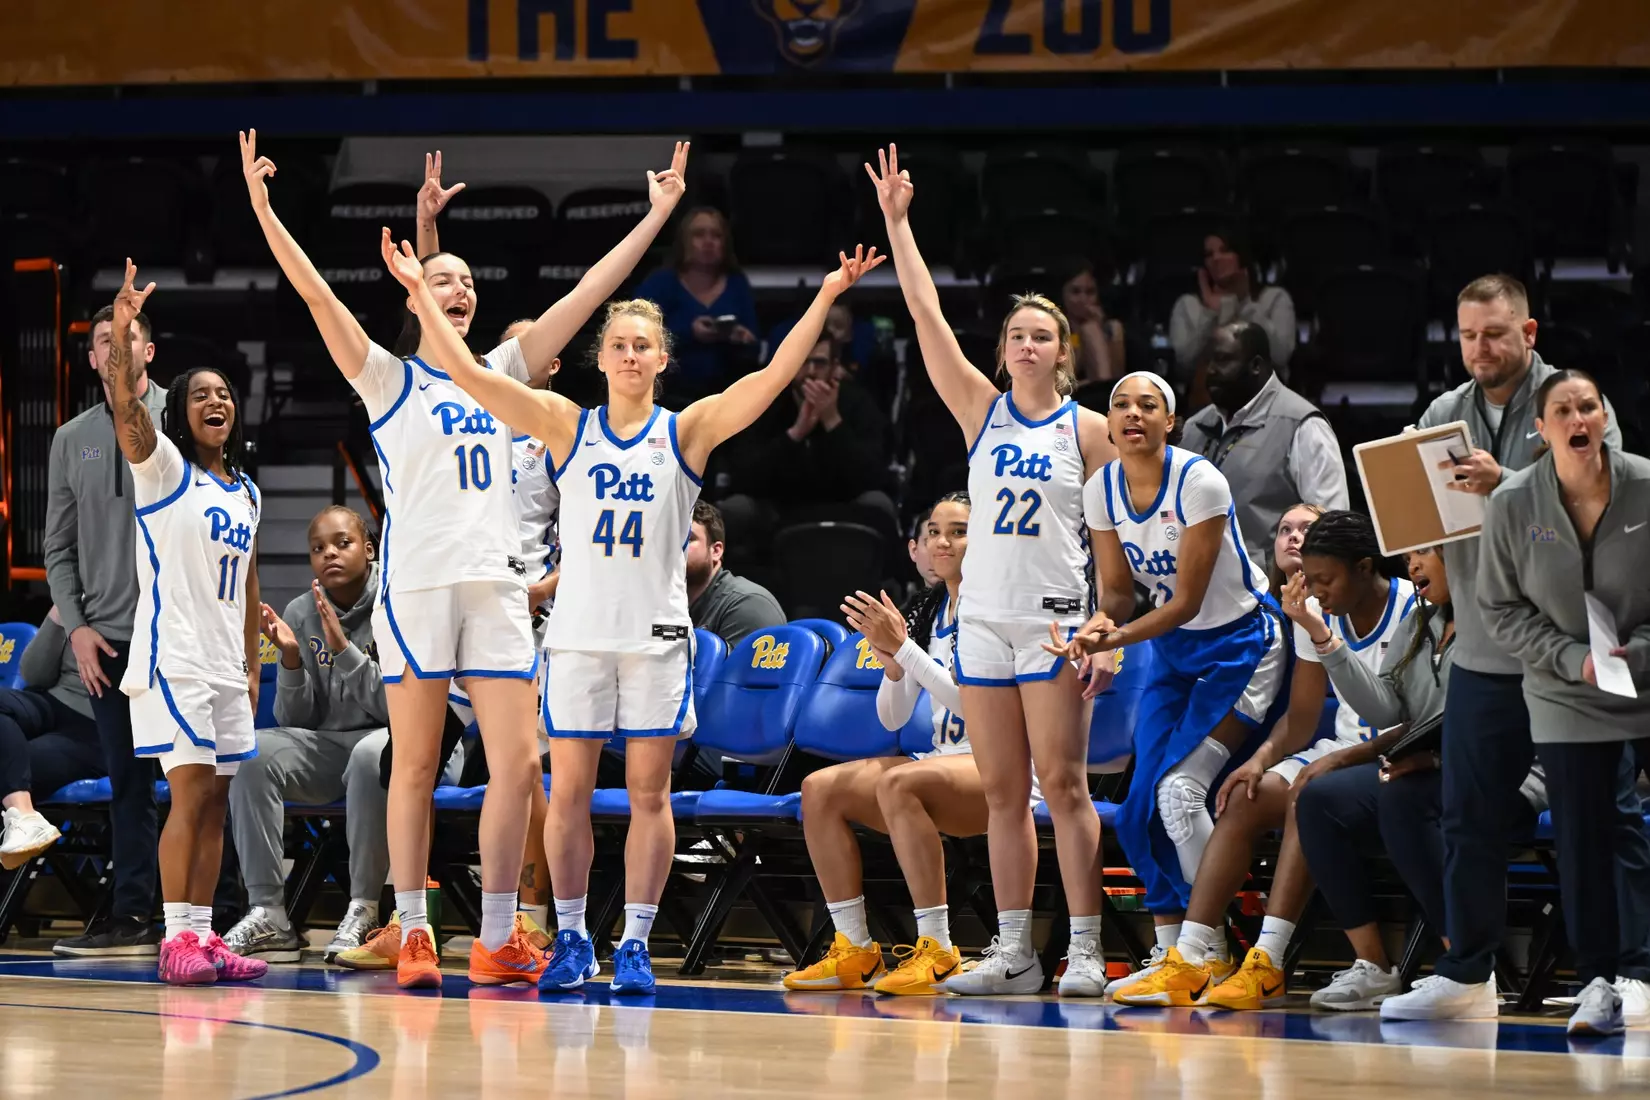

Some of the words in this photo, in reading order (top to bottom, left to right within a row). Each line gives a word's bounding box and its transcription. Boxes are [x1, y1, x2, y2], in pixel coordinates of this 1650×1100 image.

[448, 206, 539, 220] RESERVED
[431, 401, 497, 435] Pitt
[454, 443, 492, 492] 10
[991, 443, 1052, 482] Pitt
[588, 463, 655, 502] Pitt
[204, 506, 251, 553] Pitt
[992, 487, 1042, 537] 22
[592, 509, 644, 558] 44
[218, 553, 240, 601] 11
[1122, 541, 1177, 577] Pitt
[751, 634, 790, 669] Pitt
[940, 707, 965, 745] 15
